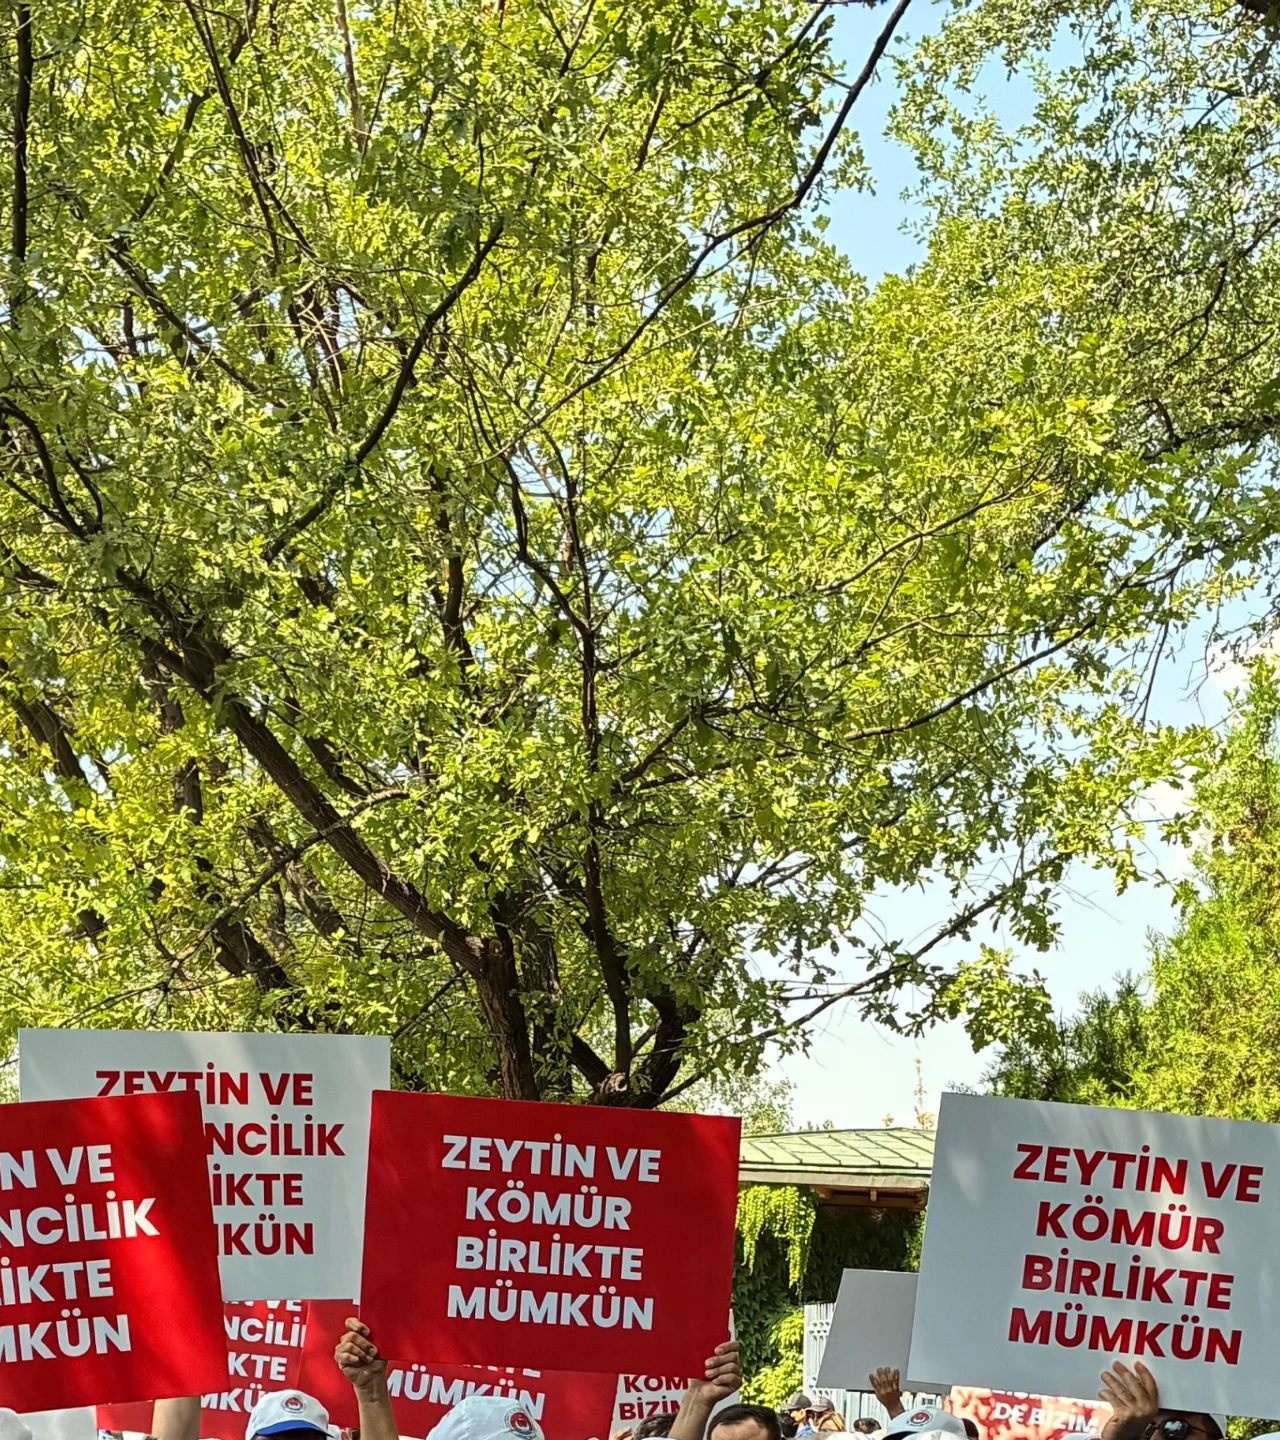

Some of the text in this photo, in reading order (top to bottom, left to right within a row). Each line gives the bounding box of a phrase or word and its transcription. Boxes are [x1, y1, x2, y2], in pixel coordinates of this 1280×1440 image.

[96, 1062, 314, 1106] ZEYTİN VE
[46, 1144, 115, 1185] VE
[441, 1133, 662, 1184] ZEYTİN VE
[1013, 1145, 1265, 1204] ZEYTİN VE
[465, 1179, 632, 1231] KÖMÜR
[1036, 1194, 1225, 1255] KÖMÜR
[214, 1213, 314, 1256] KÜN
[455, 1229, 644, 1282] BİRLİKTE
[447, 1279, 654, 1331] MÜMKÜN
[1021, 1248, 1236, 1311] BİRLİKTE
[1008, 1302, 1243, 1366] MÜMKÜN
